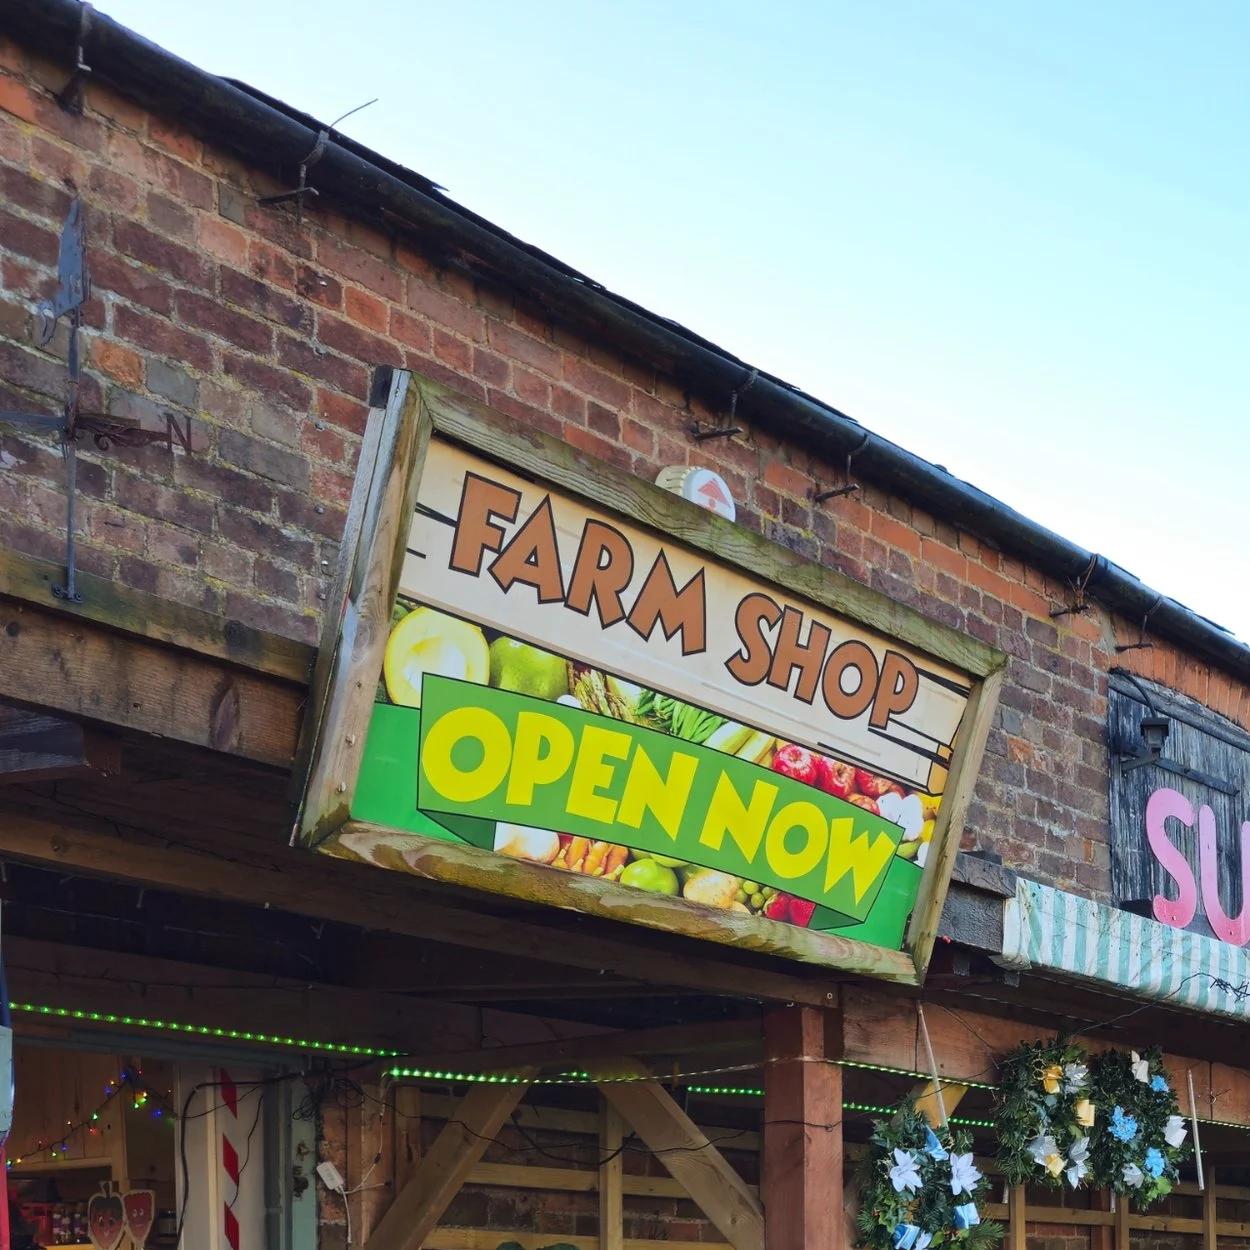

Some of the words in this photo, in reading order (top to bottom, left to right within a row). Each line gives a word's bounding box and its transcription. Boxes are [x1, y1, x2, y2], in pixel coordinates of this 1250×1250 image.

[448, 471, 706, 656] FARM
[724, 593, 919, 730] SHOP
[421, 706, 703, 841] OPEN
[699, 768, 900, 906] NOW
